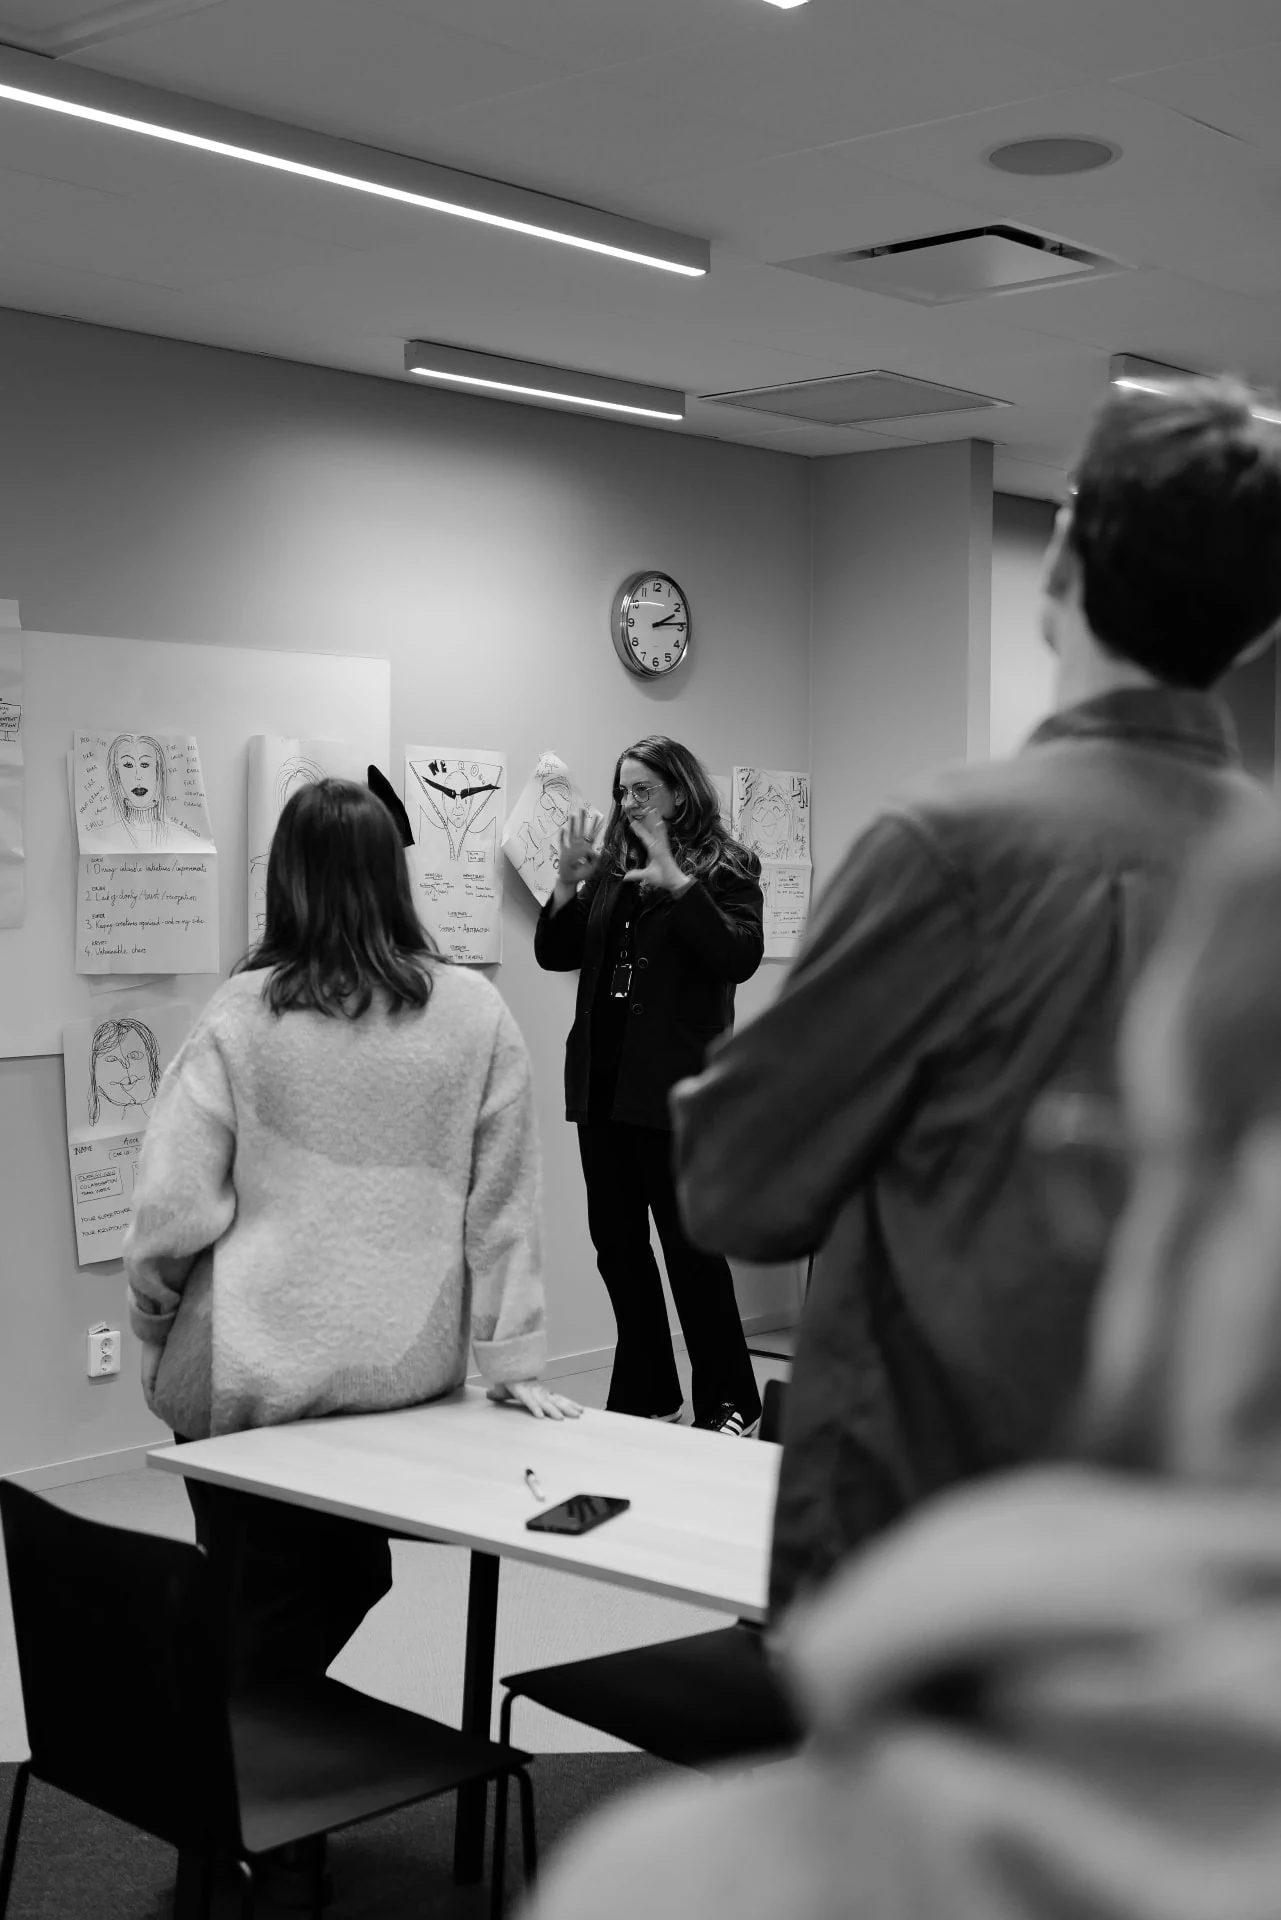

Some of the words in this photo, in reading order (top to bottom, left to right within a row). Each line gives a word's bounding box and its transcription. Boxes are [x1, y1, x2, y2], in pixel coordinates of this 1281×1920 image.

[642, 587, 647, 598] 11
[653, 582, 662, 593] 12
[668, 588, 671, 598] 1
[632, 599, 640, 610] 10
[673, 603, 681, 613] 2
[628, 617, 635, 628] 9
[677, 622, 685, 632] 3
[631, 637, 639, 647] 8
[673, 639, 681, 649] 4
[640, 651, 647, 662] 7
[652, 657, 660, 667] 6
[664, 652, 672, 663] 5
[74, 1145, 93, 1156] NAME
